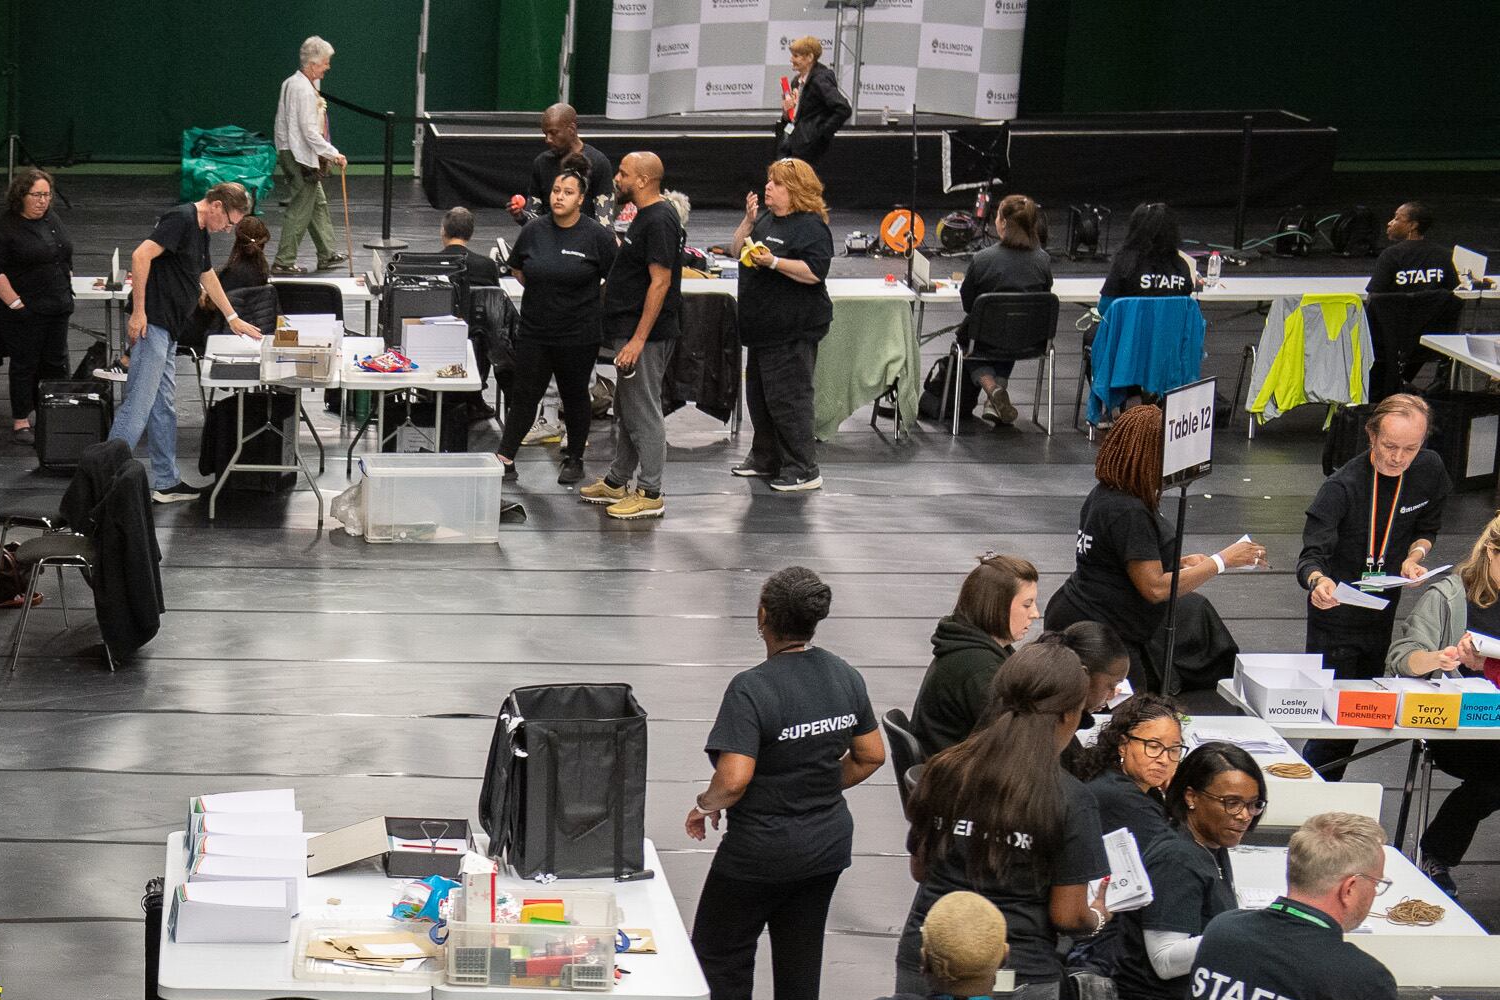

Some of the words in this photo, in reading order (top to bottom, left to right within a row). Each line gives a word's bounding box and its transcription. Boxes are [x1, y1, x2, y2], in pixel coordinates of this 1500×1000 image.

[938, 42, 973, 52] ISLINGTON
[712, 83, 753, 91] ISLINGTON
[863, 83, 906, 92] ISLINGTON
[1396, 268, 1444, 285] STAFF
[1168, 412, 1199, 442] Table
[1200, 405, 1212, 431] 12
[1281, 698, 1308, 707] Lesley
[1268, 707, 1319, 716] WOODBURN
[1355, 703, 1378, 713] Emily
[1417, 704, 1445, 715] Terry
[1463, 703, 1494, 712] Imogen
[1340, 712, 1392, 721] THORNBERRY
[1411, 715, 1449, 726] STACY
